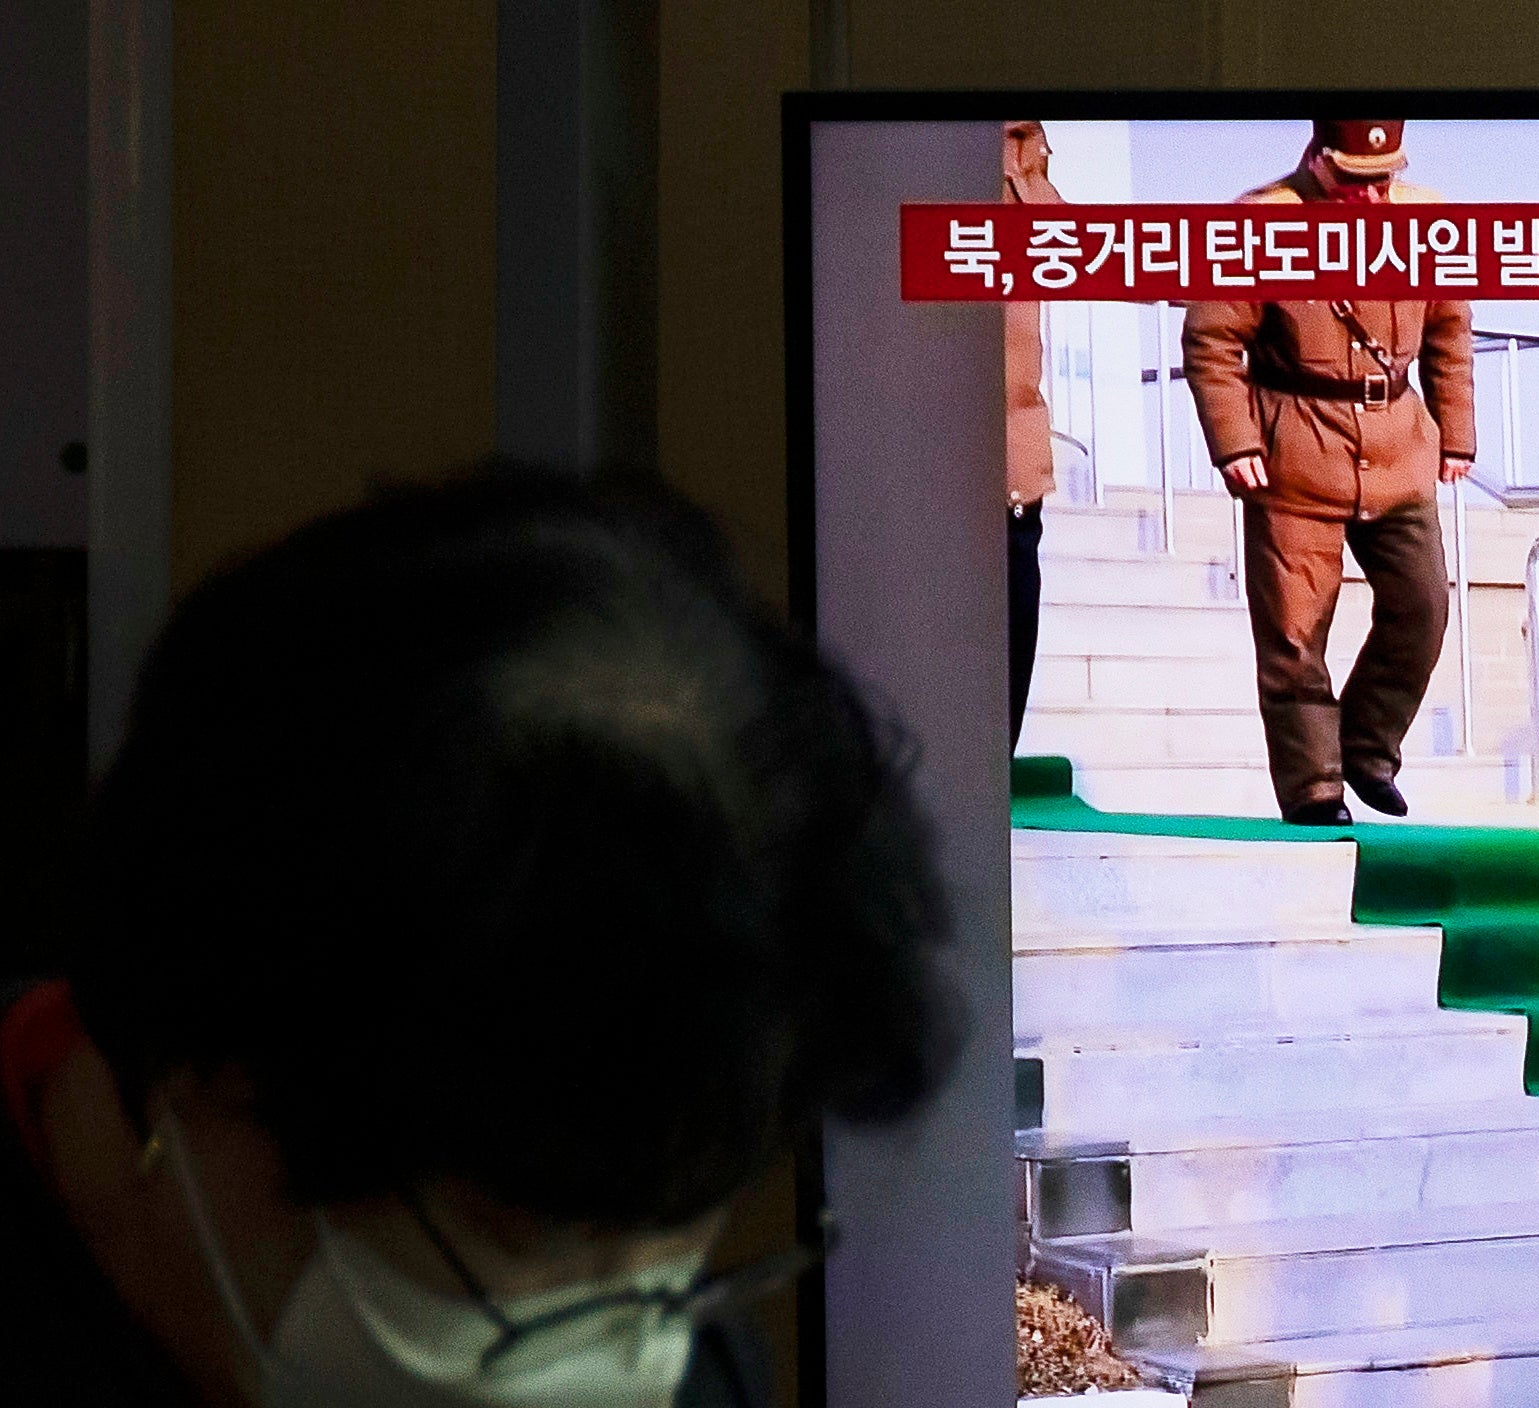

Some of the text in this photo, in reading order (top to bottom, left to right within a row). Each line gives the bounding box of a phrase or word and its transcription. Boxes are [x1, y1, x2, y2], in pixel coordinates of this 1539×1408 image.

[944, 219, 1013, 295] 북,
[1027, 219, 1189, 288] 중거리
[1207, 219, 1478, 287] 탄도미사일
